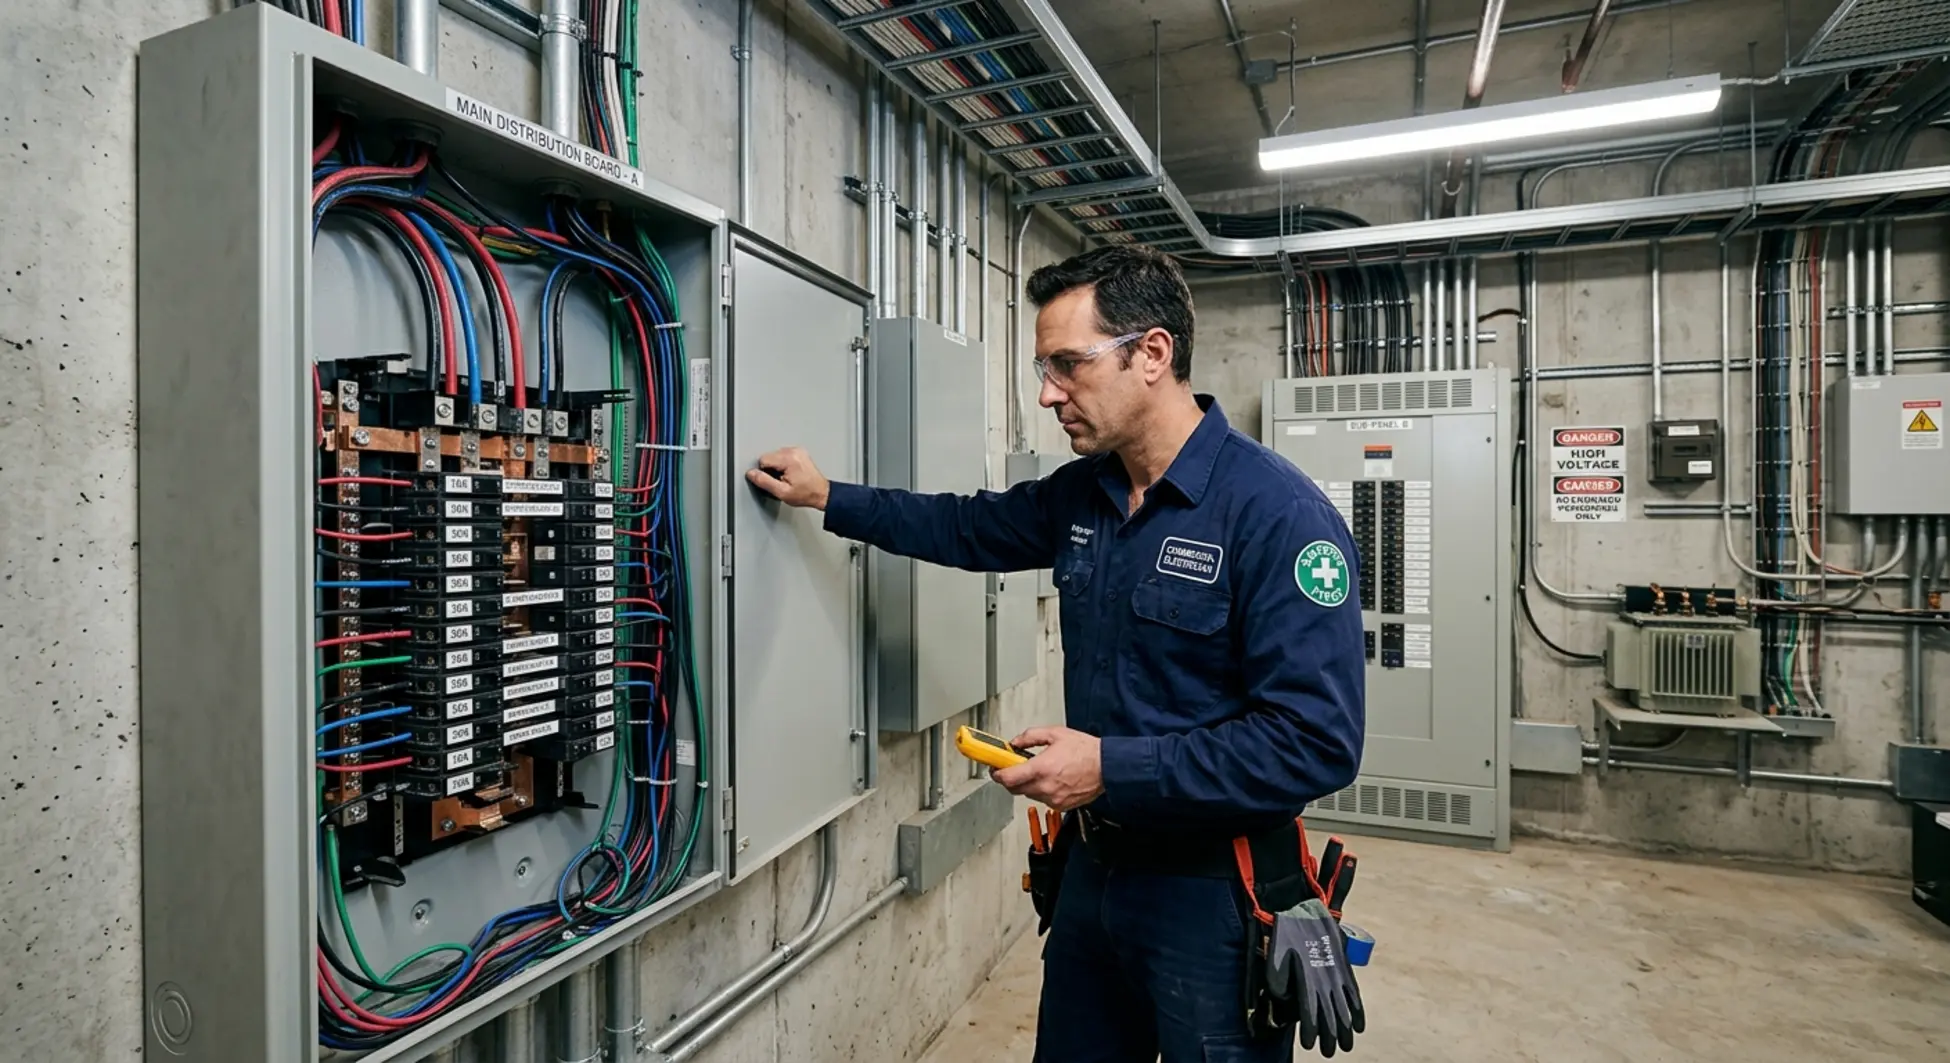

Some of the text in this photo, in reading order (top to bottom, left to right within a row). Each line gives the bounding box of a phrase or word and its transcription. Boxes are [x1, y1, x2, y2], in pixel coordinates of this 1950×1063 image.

[456, 96, 493, 126] MAIN
[496, 114, 582, 163] DISTRIBUTION
[631, 172, 639, 186] A
